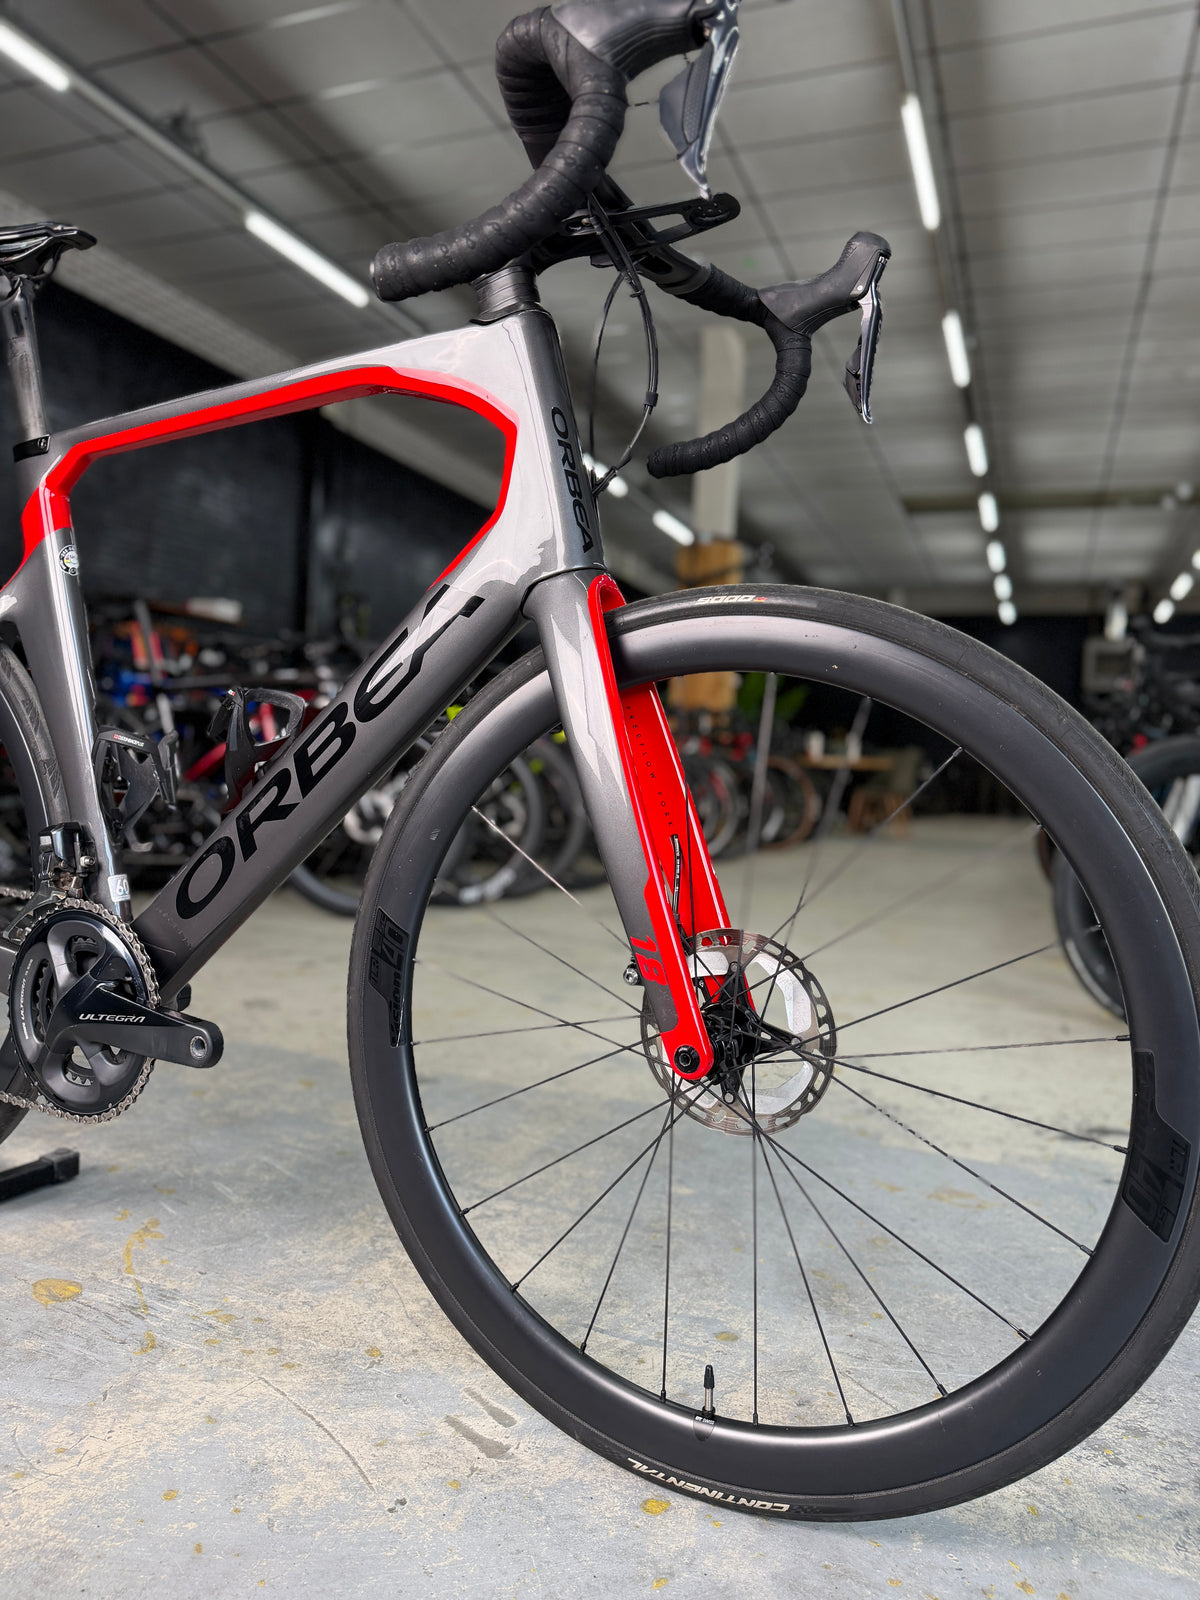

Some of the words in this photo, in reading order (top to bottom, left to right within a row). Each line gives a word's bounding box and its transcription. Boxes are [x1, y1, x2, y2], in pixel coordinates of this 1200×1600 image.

[551, 406, 594, 554] ORBEA
[175, 583, 486, 920] ORBEA
[630, 934, 668, 986] 18
[78, 1013, 147, 1023] ULTEGRA
[627, 1457, 791, 1512] CONTINENTAL
